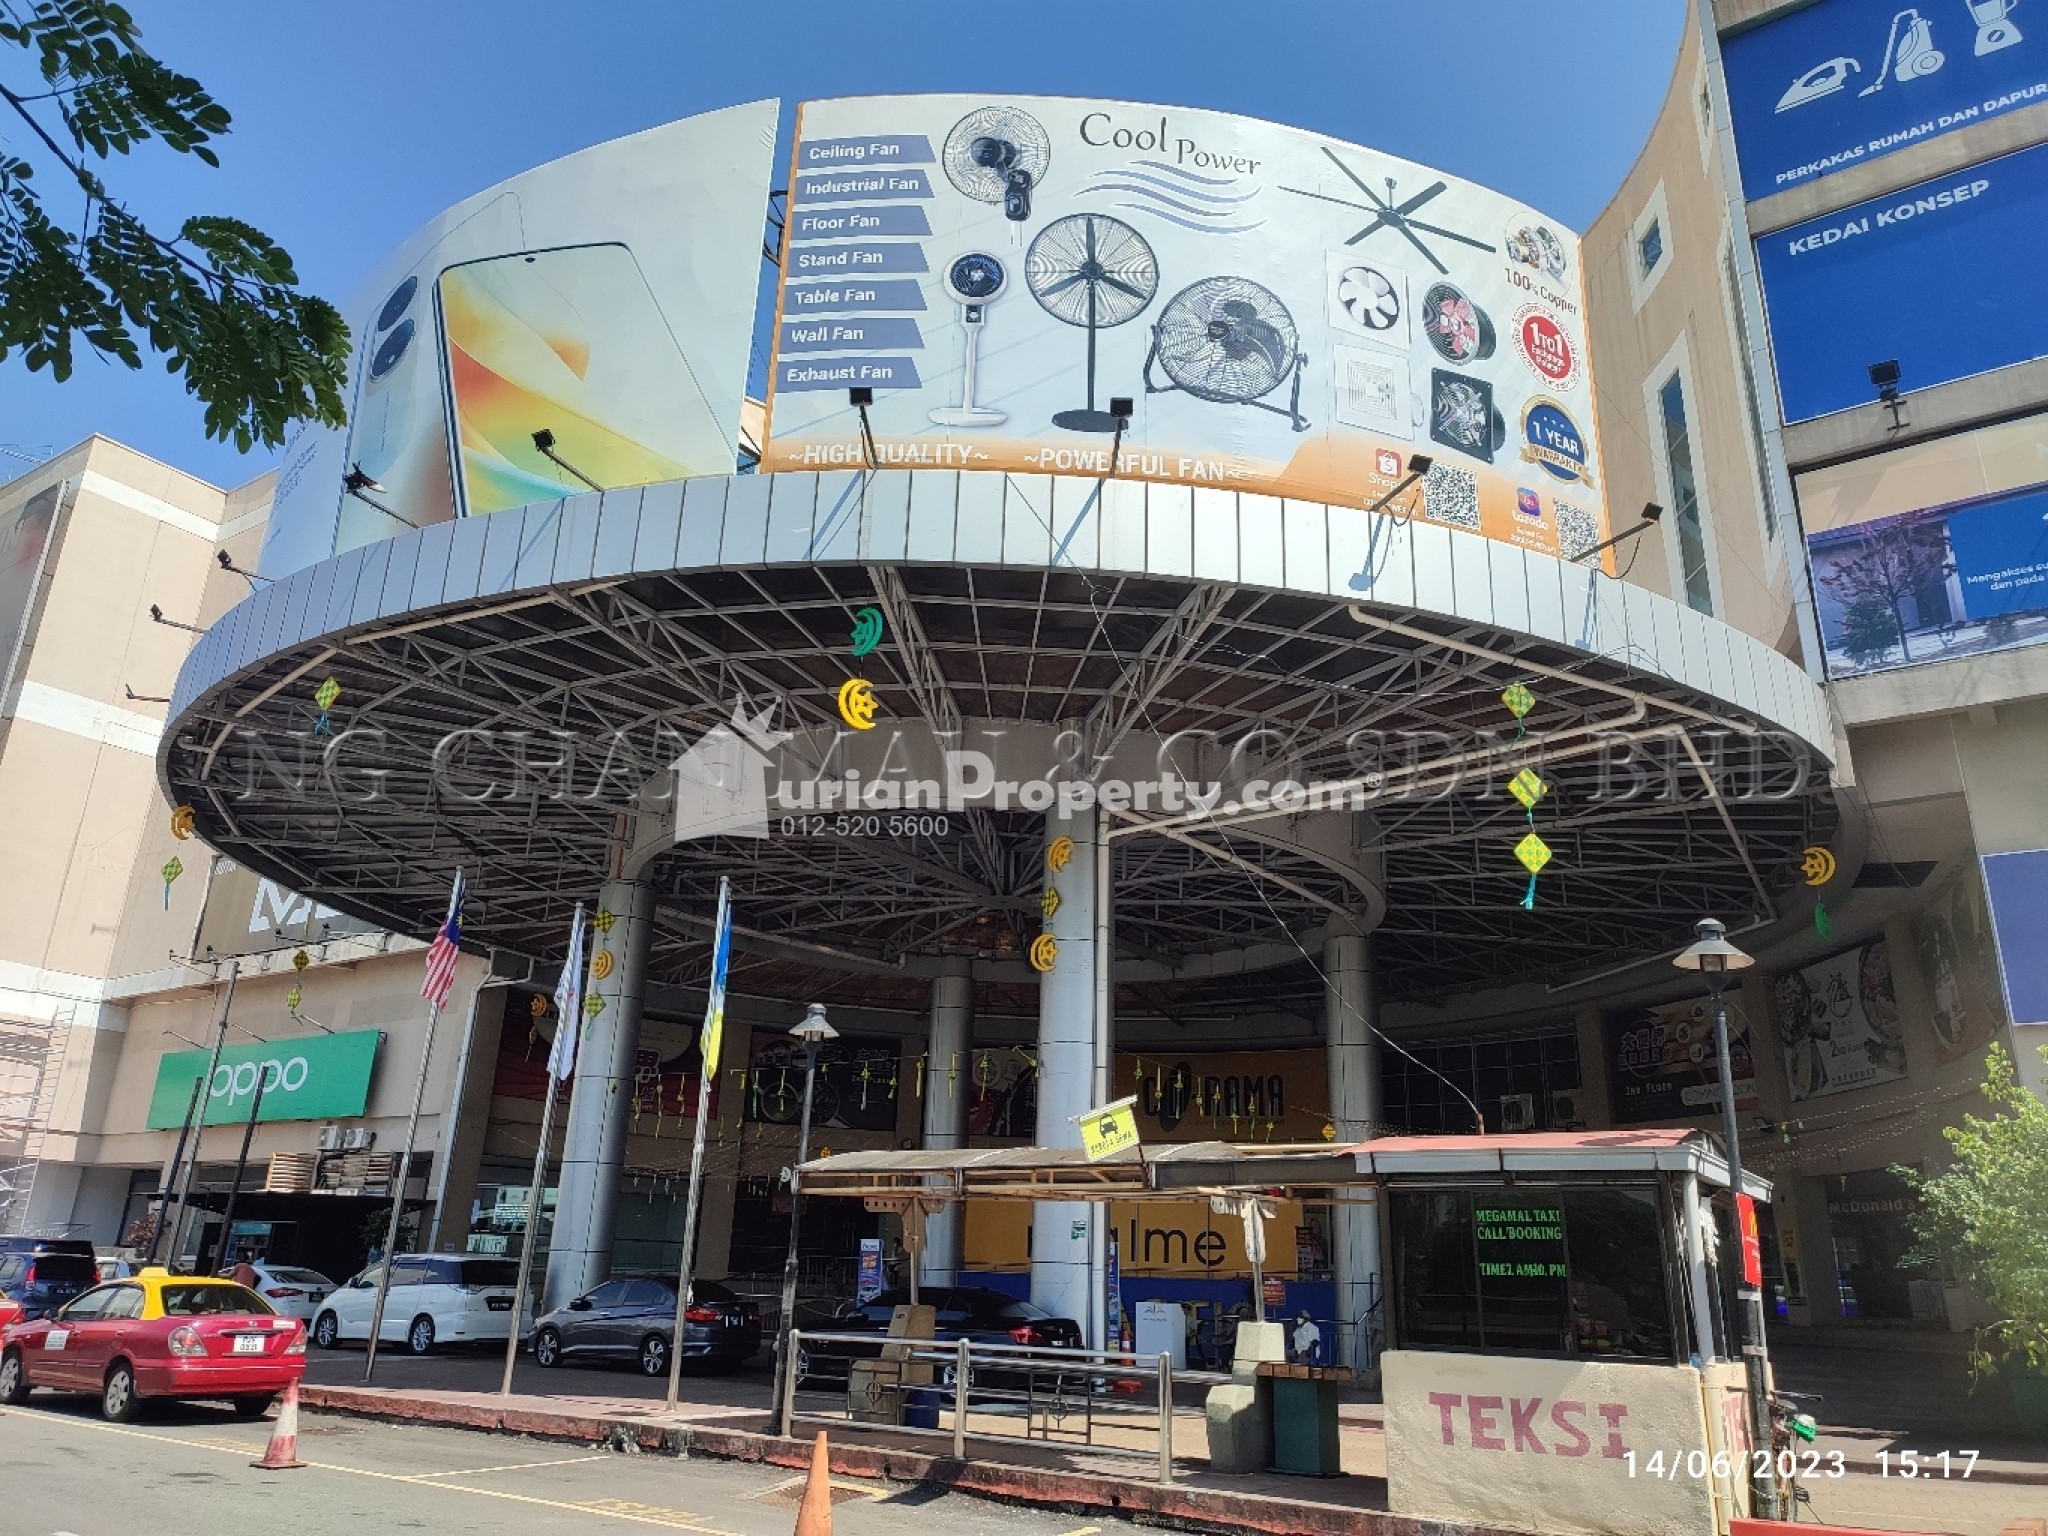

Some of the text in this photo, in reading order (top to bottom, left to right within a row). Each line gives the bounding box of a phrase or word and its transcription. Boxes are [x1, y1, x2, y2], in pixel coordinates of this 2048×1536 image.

[1775, 83, 2048, 184] PERKAKAS RUMAH DAN DAPUR
[808, 141, 900, 160] Ceiling Fan
[1079, 112, 1262, 175] Cool Power
[805, 176, 919, 196] Industrial Fan
[802, 214, 880, 232] Floor Fan
[1788, 179, 1990, 256] KEDAI KONSEP
[798, 250, 884, 268] Stand Fan
[794, 288, 876, 305] Table Fan
[1540, 286, 1577, 316] Copper
[790, 326, 864, 343] Wall Fan
[786, 364, 893, 383] Exhaust Fan
[1532, 420, 1580, 457] 1 YEAR
[2015, 573, 2045, 588] pada
[210, 1056, 309, 1107] oppo
[1475, 1209, 1561, 1222] MEGAMAL TAXI
[1428, 1391, 1631, 1460] TEKSI
